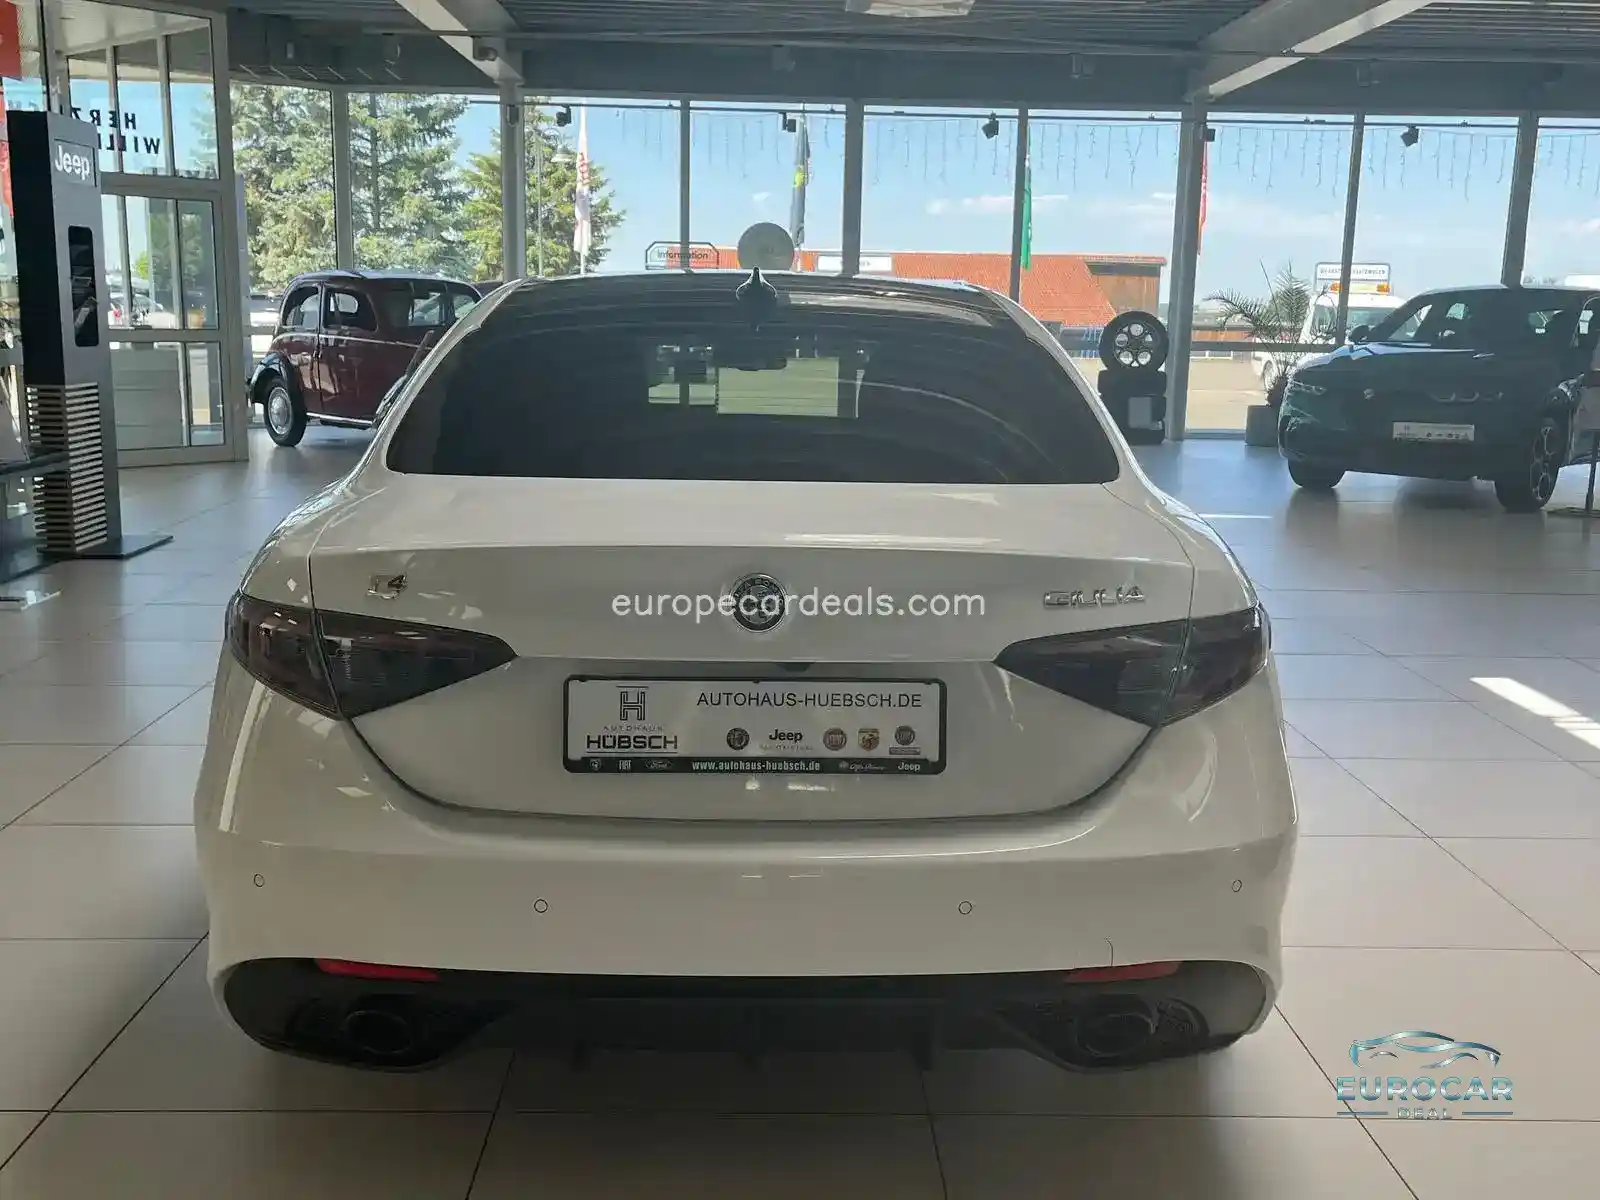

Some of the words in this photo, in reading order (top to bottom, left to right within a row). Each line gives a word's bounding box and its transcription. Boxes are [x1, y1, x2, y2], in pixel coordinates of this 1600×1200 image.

[54, 145, 90, 181] Jeep
[1043, 585, 1146, 607] GIULIA
[697, 692, 922, 708] AUTOHAUS-HUEBSCH.DE
[586, 734, 678, 750] HÜBSCH
[768, 728, 803, 743] Jeep
[692, 761, 820, 771] www.autohaus-huebsch.de
[898, 762, 920, 772] Jeep
